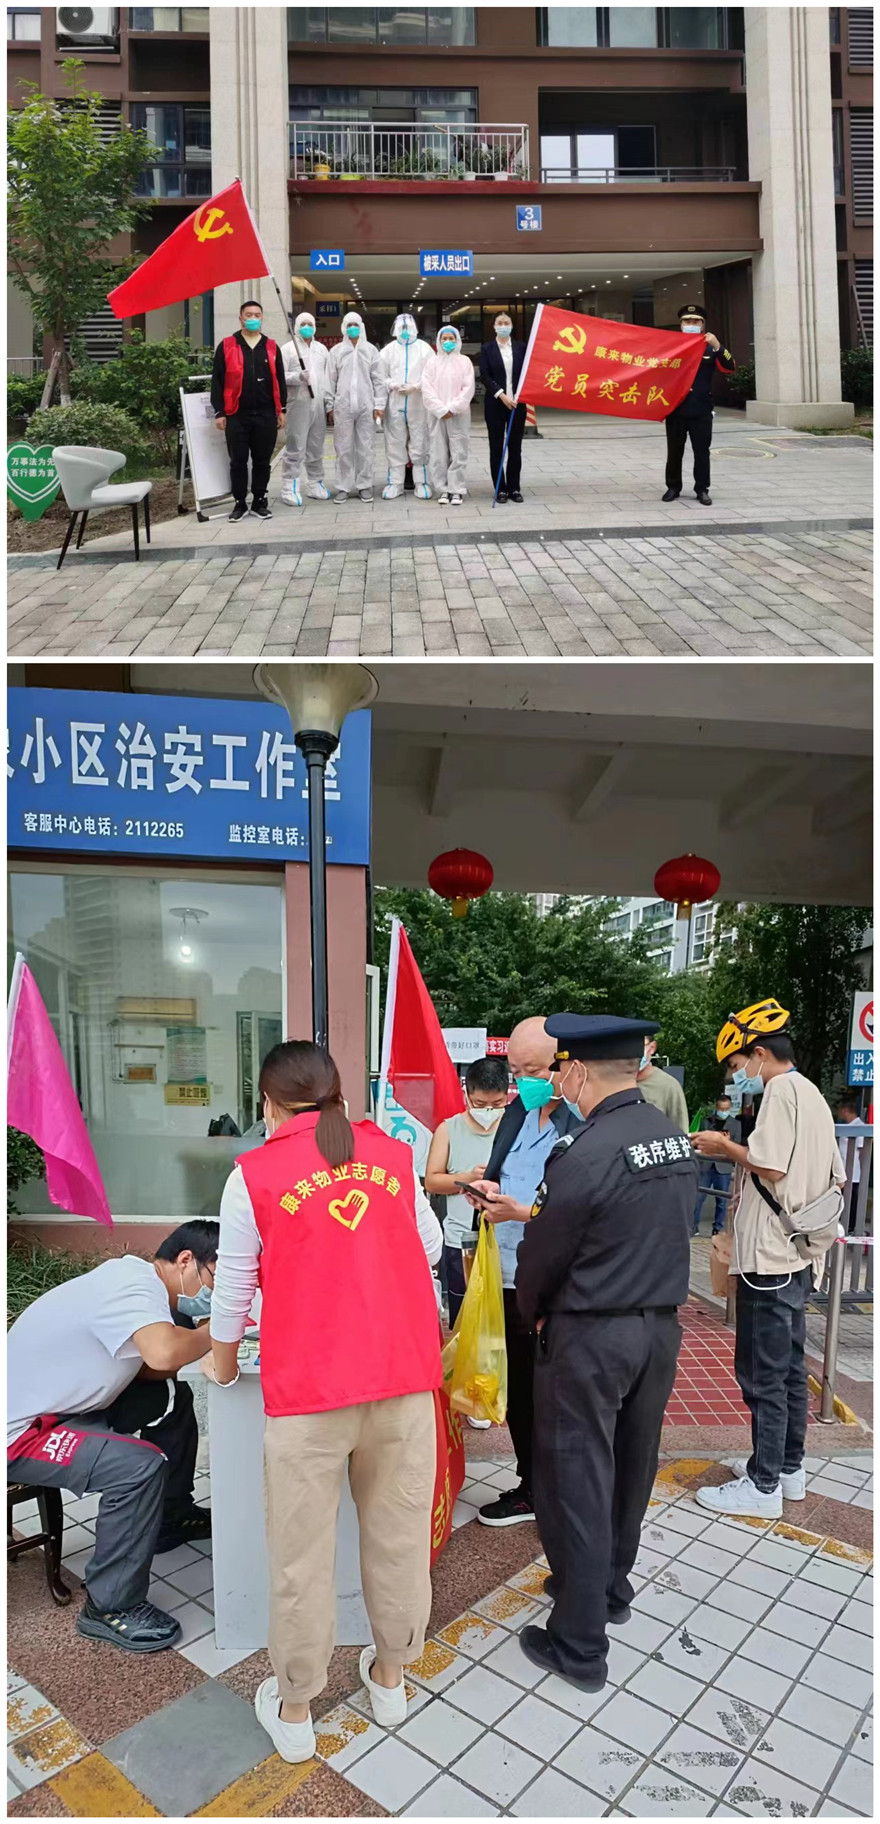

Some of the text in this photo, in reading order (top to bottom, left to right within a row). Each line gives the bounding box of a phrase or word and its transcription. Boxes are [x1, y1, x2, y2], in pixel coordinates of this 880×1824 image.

[525, 207, 534, 220] 3
[315, 254, 340, 266] 入口
[423, 255, 470, 272] 被采人员出口
[594, 345, 682, 370] 康来物业党支部
[544, 365, 670, 407] 党员突击队
[628, 1136, 691, 1168] 秩序维护
[279, 1162, 401, 1215] 康来物业志愿者
[42, 1430, 67, 1460] JDL
